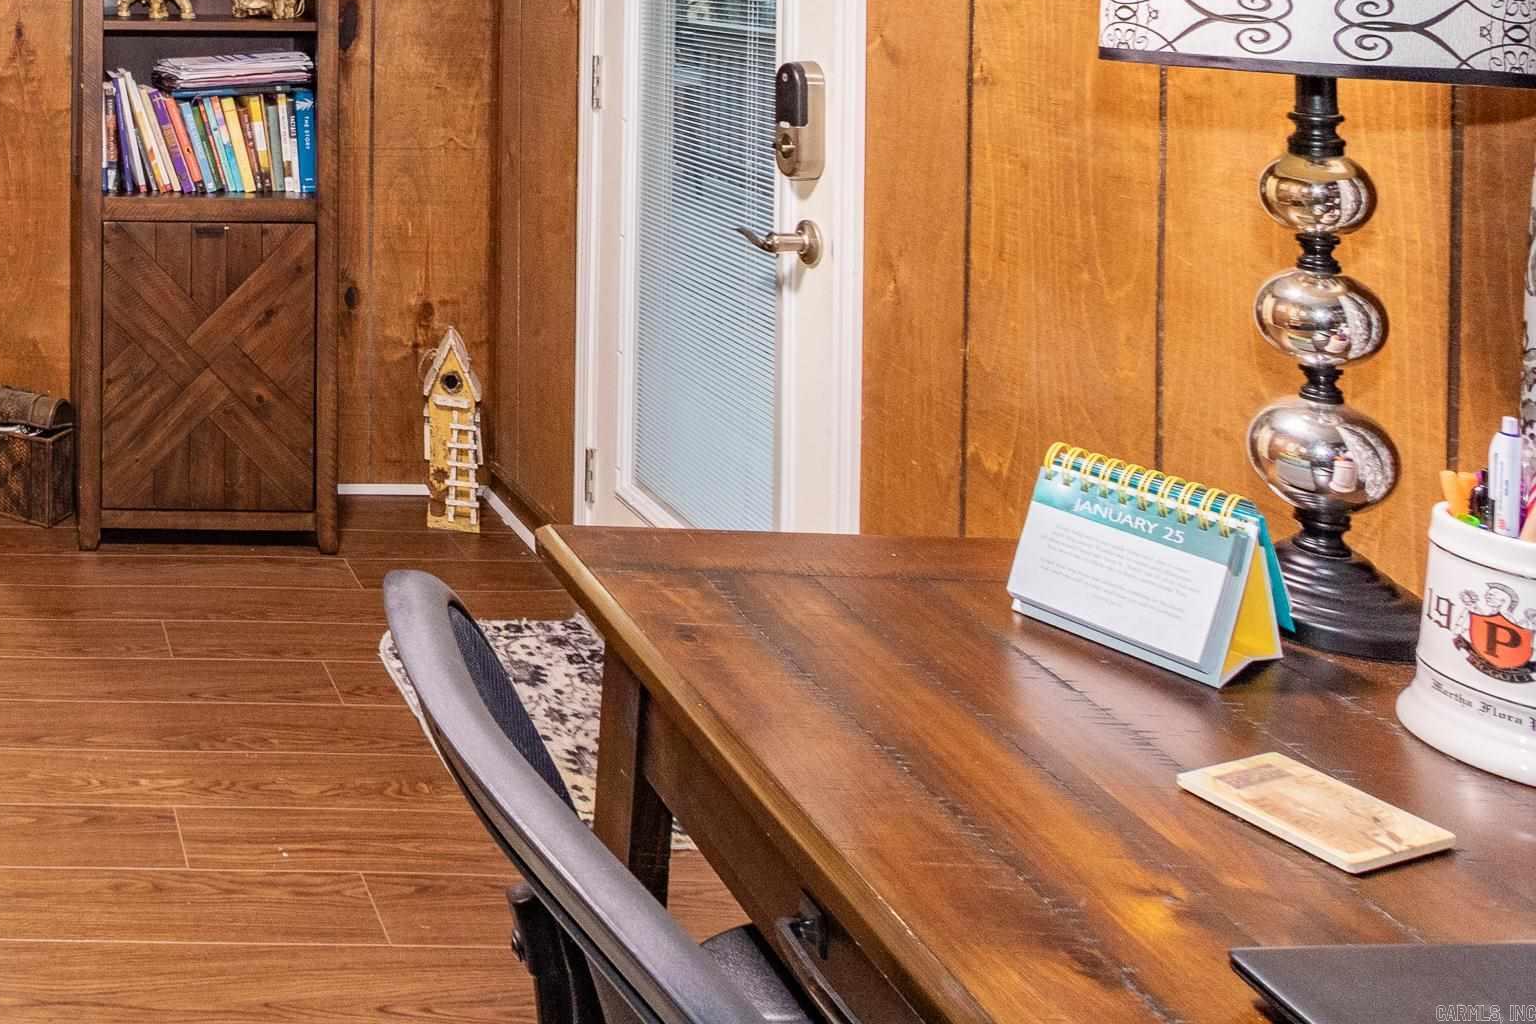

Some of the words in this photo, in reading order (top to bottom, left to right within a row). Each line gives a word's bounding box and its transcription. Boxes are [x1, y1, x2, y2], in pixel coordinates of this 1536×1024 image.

[1072, 497, 1159, 535] JANUARY
[1163, 526, 1185, 544] 25
[1426, 587, 1455, 631] 19
[1483, 619, 1522, 658] P
